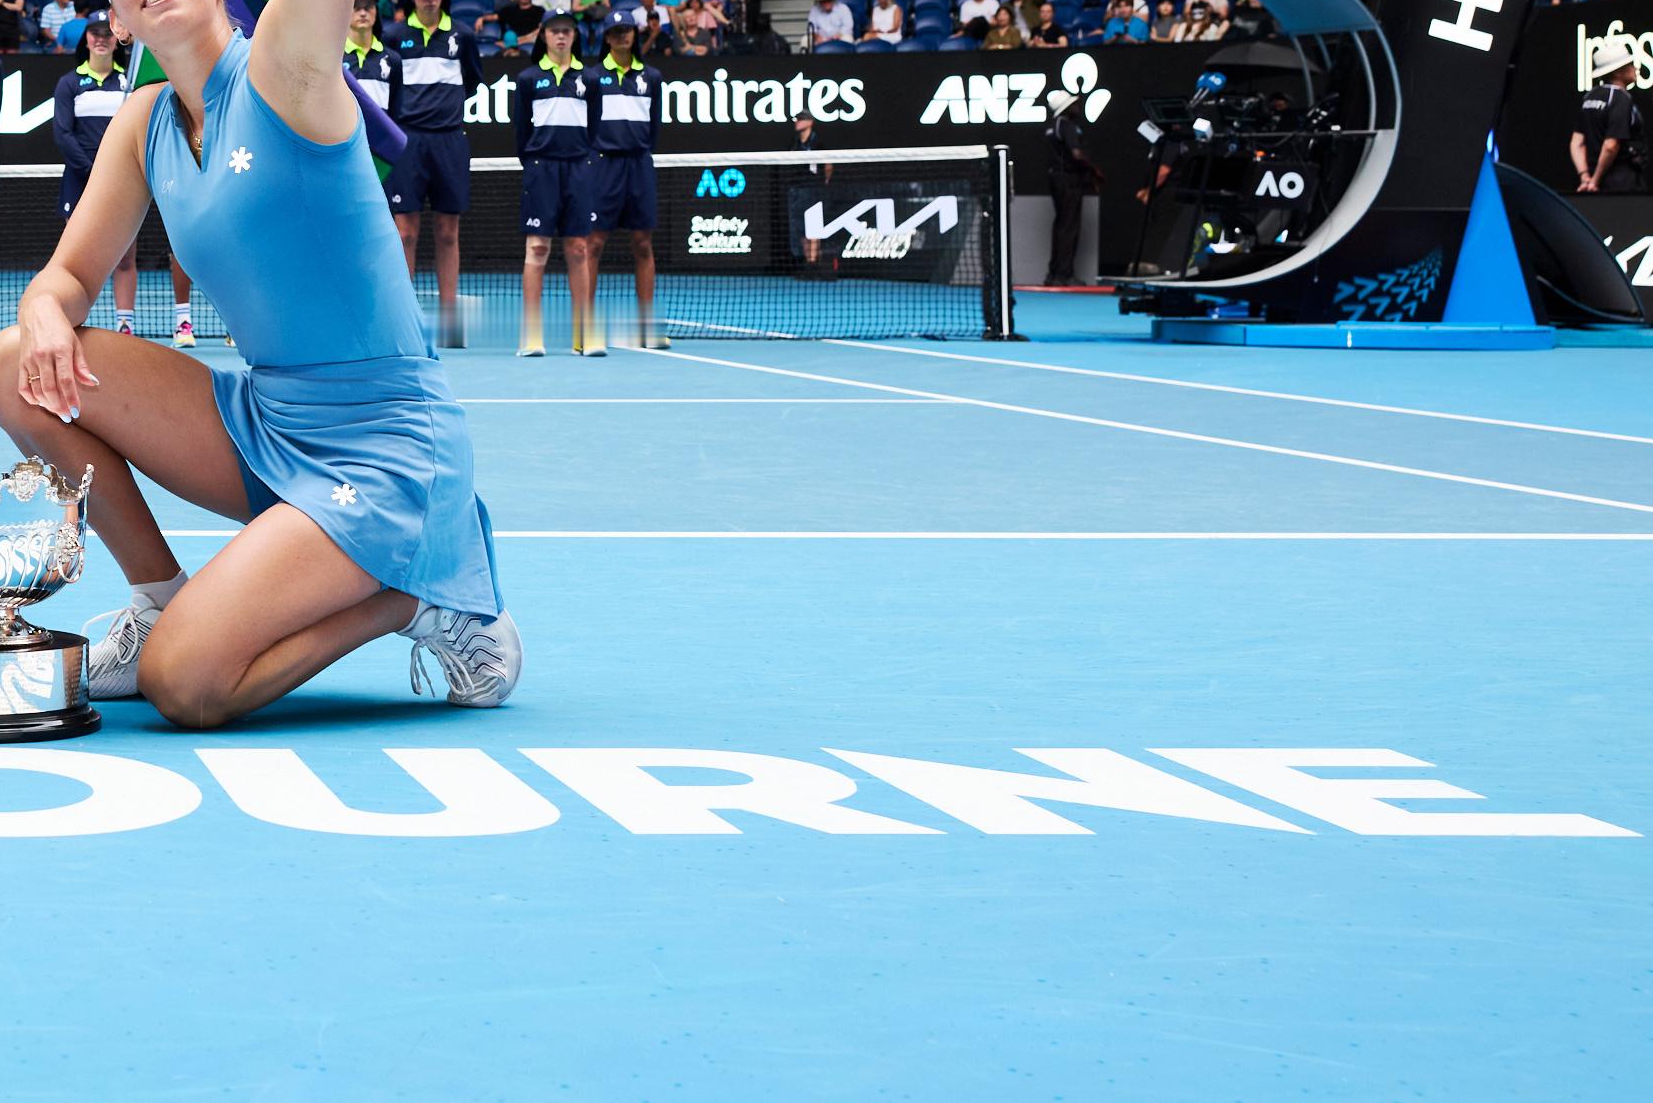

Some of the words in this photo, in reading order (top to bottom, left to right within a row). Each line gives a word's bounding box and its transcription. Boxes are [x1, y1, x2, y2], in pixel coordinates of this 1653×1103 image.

[660, 68, 867, 124] mirates
[919, 73, 1047, 125] ANZ
[696, 168, 746, 198] AO
[1255, 171, 1305, 198] AO
[691, 215, 749, 236] Safety
[688, 232, 752, 250] Culture
